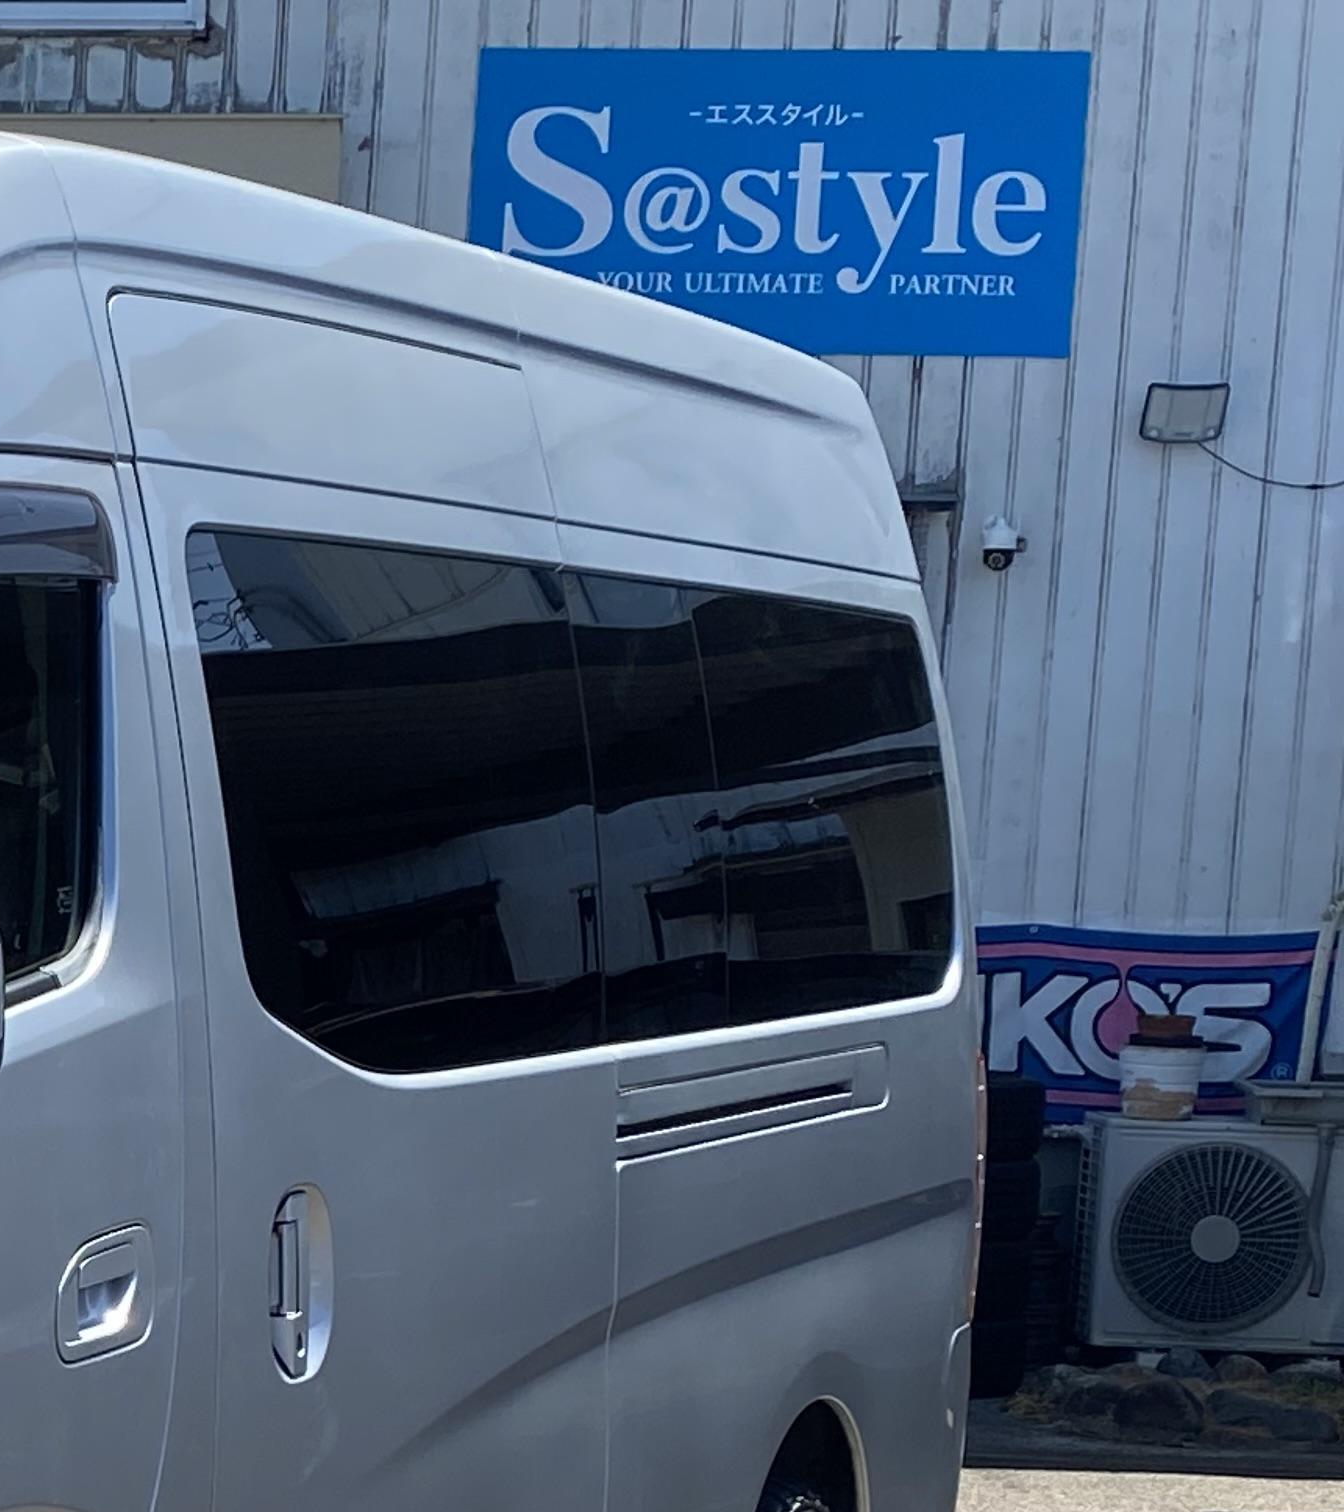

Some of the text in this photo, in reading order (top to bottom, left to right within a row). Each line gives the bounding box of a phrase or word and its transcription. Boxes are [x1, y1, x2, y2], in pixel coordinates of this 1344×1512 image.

[502, 105, 1047, 293] S@style
[685, 271, 823, 295] ULTIMATE
[889, 274, 1016, 296] PARTNER
